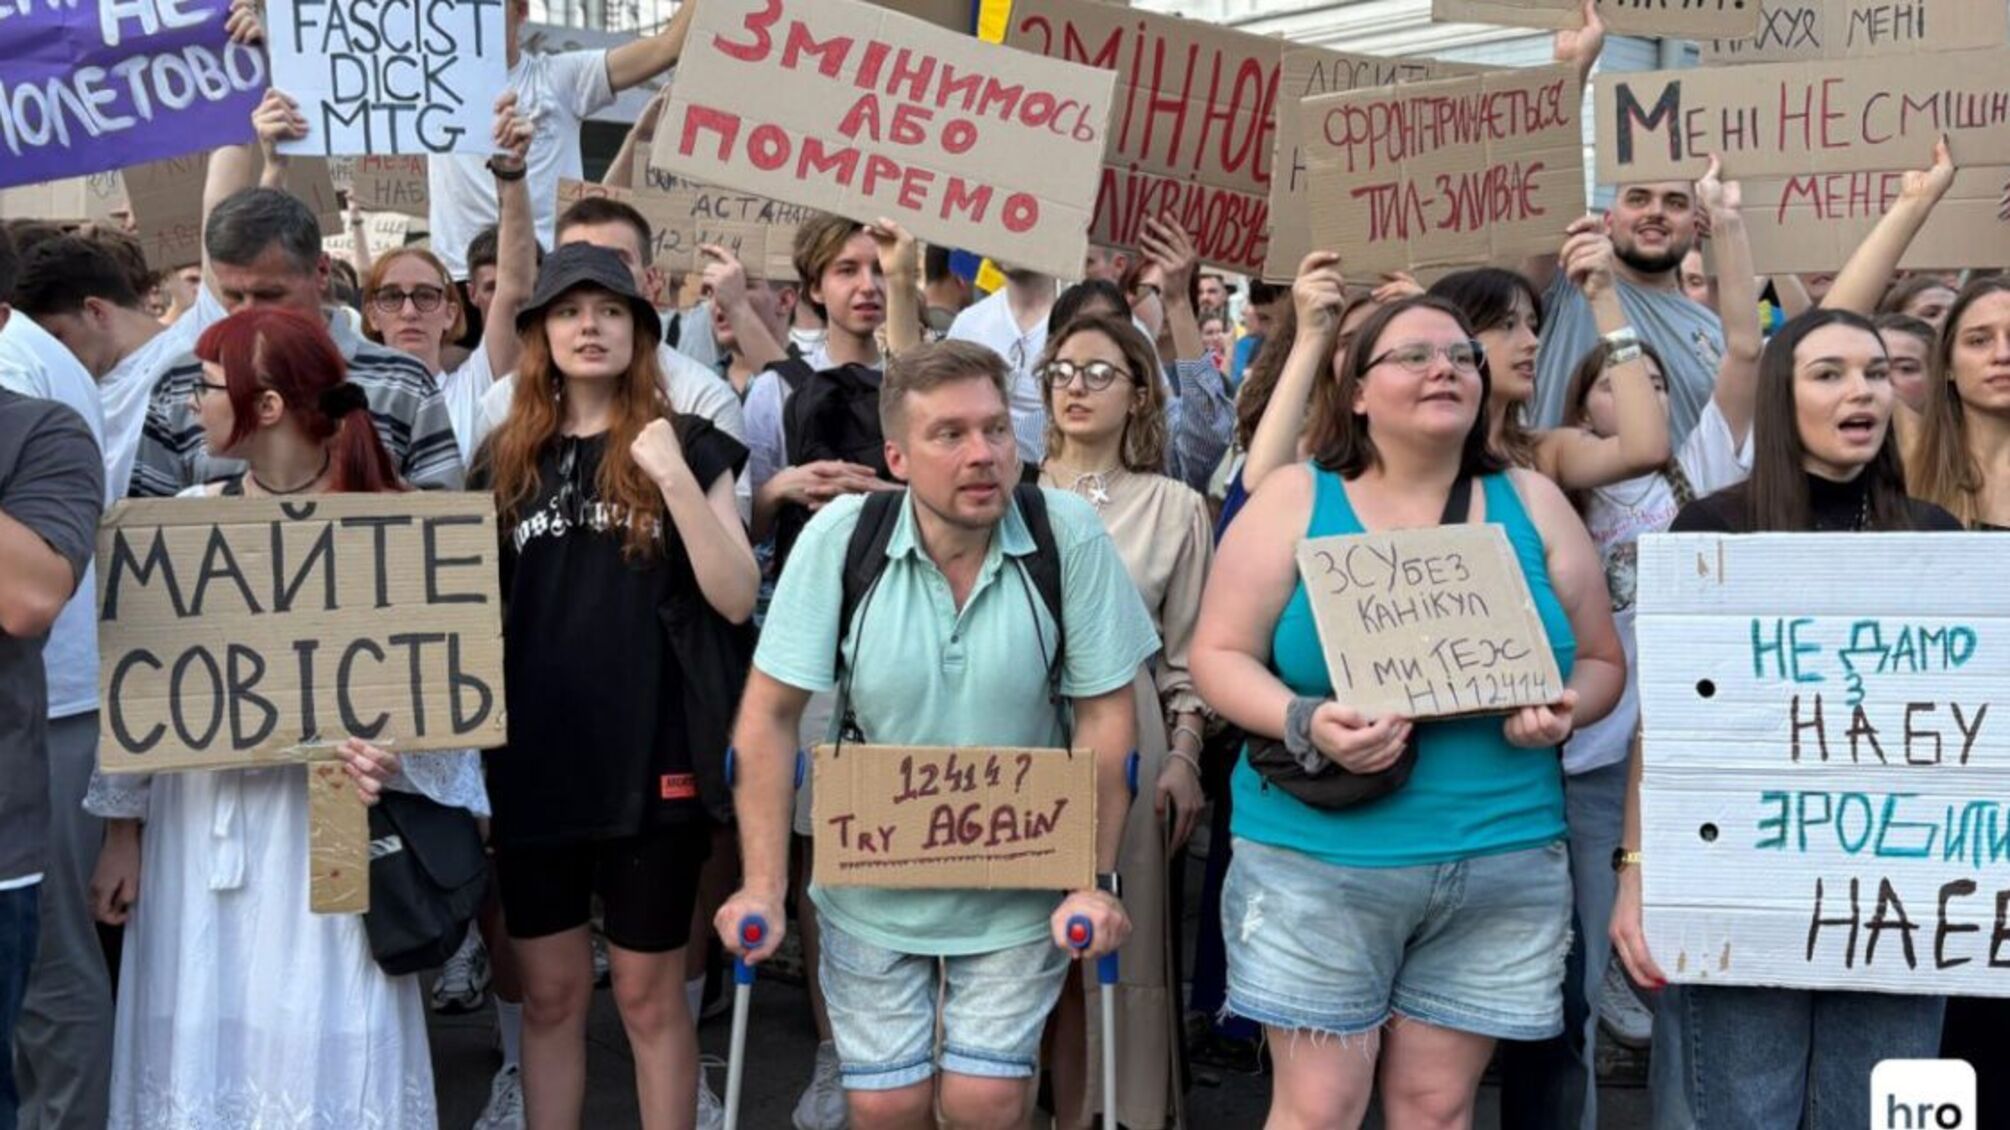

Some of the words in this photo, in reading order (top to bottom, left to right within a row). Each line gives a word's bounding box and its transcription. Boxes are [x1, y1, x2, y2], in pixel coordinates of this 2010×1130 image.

[292, 0, 501, 57] FASCIST
[1712, 8, 1820, 53] ХУЯ
[1848, 1, 1925, 47] МЕНІ
[330, 53, 464, 105] DICK
[712, 0, 1095, 142] ЗМІНИМОСЬ
[320, 98, 466, 155] MTG
[837, 92, 978, 155] АБО
[1616, 80, 1758, 165] МЕНІ
[1779, 78, 1850, 152] НЕ
[678, 104, 1039, 233] ПОМРЕМО
[101, 502, 488, 620] МАЙТЕ
[1357, 591, 1490, 634] КАНІКУЛ
[1372, 656, 1422, 686] МИ
[1751, 618, 1826, 682] НЕ
[1838, 620, 1977, 674] ДАМО
[108, 632, 493, 754] СОВІСТЬ
[1845, 673, 1866, 705] З
[1790, 694, 1990, 765] НАБУ
[828, 814, 897, 854] TRY
